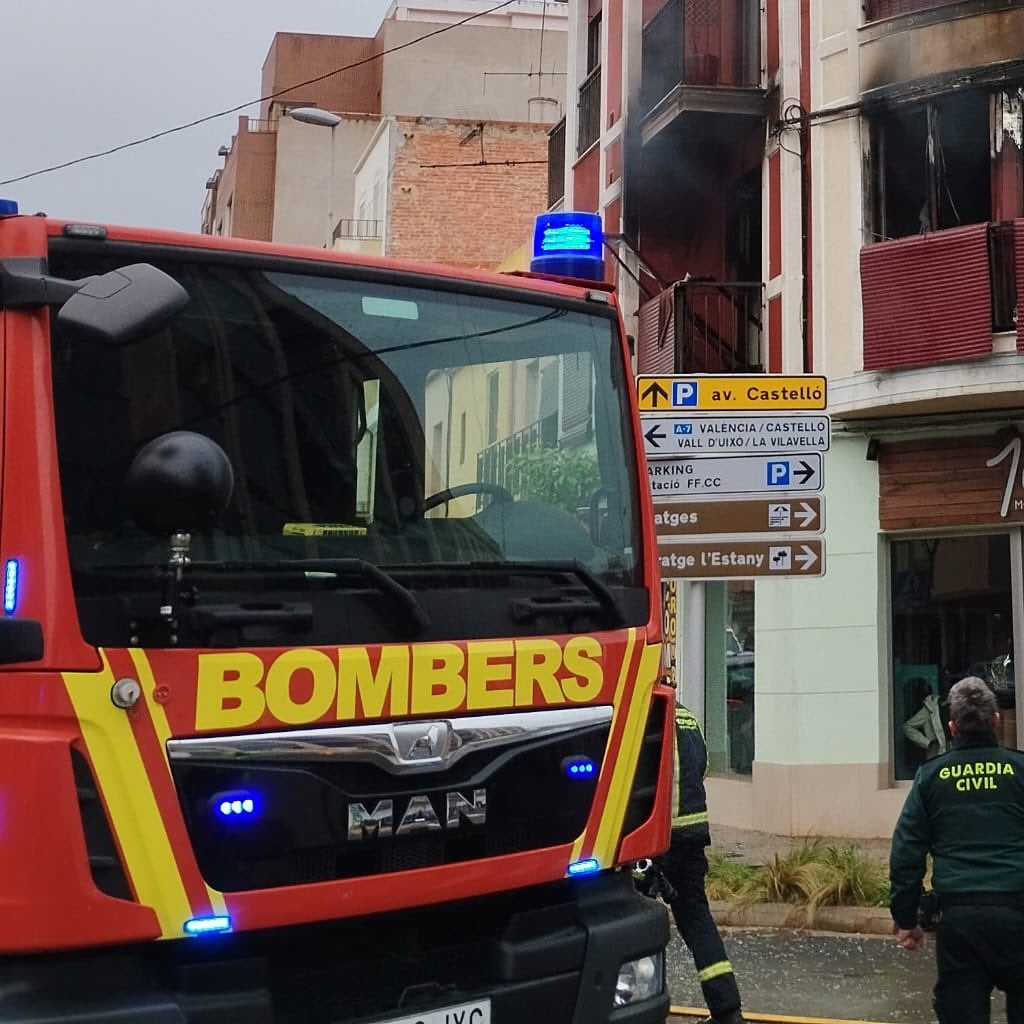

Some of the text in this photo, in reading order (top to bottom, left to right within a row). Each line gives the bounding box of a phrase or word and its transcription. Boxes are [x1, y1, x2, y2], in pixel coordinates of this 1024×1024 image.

[711, 390, 737, 401] av.
[747, 386, 823, 401] Castelló
[678, 438, 703, 448] VALL
[771, 436, 825, 447] VILAVELLA
[648, 464, 694, 476] ARKING
[652, 480, 680, 490] tació
[654, 511, 698, 526] atges
[659, 551, 764, 569] atge l'Estany
[195, 636, 603, 731] BOMBERS
[939, 762, 1015, 779] GUARDIA
[956, 776, 998, 791] CIVIL
[347, 789, 486, 841] MAN
